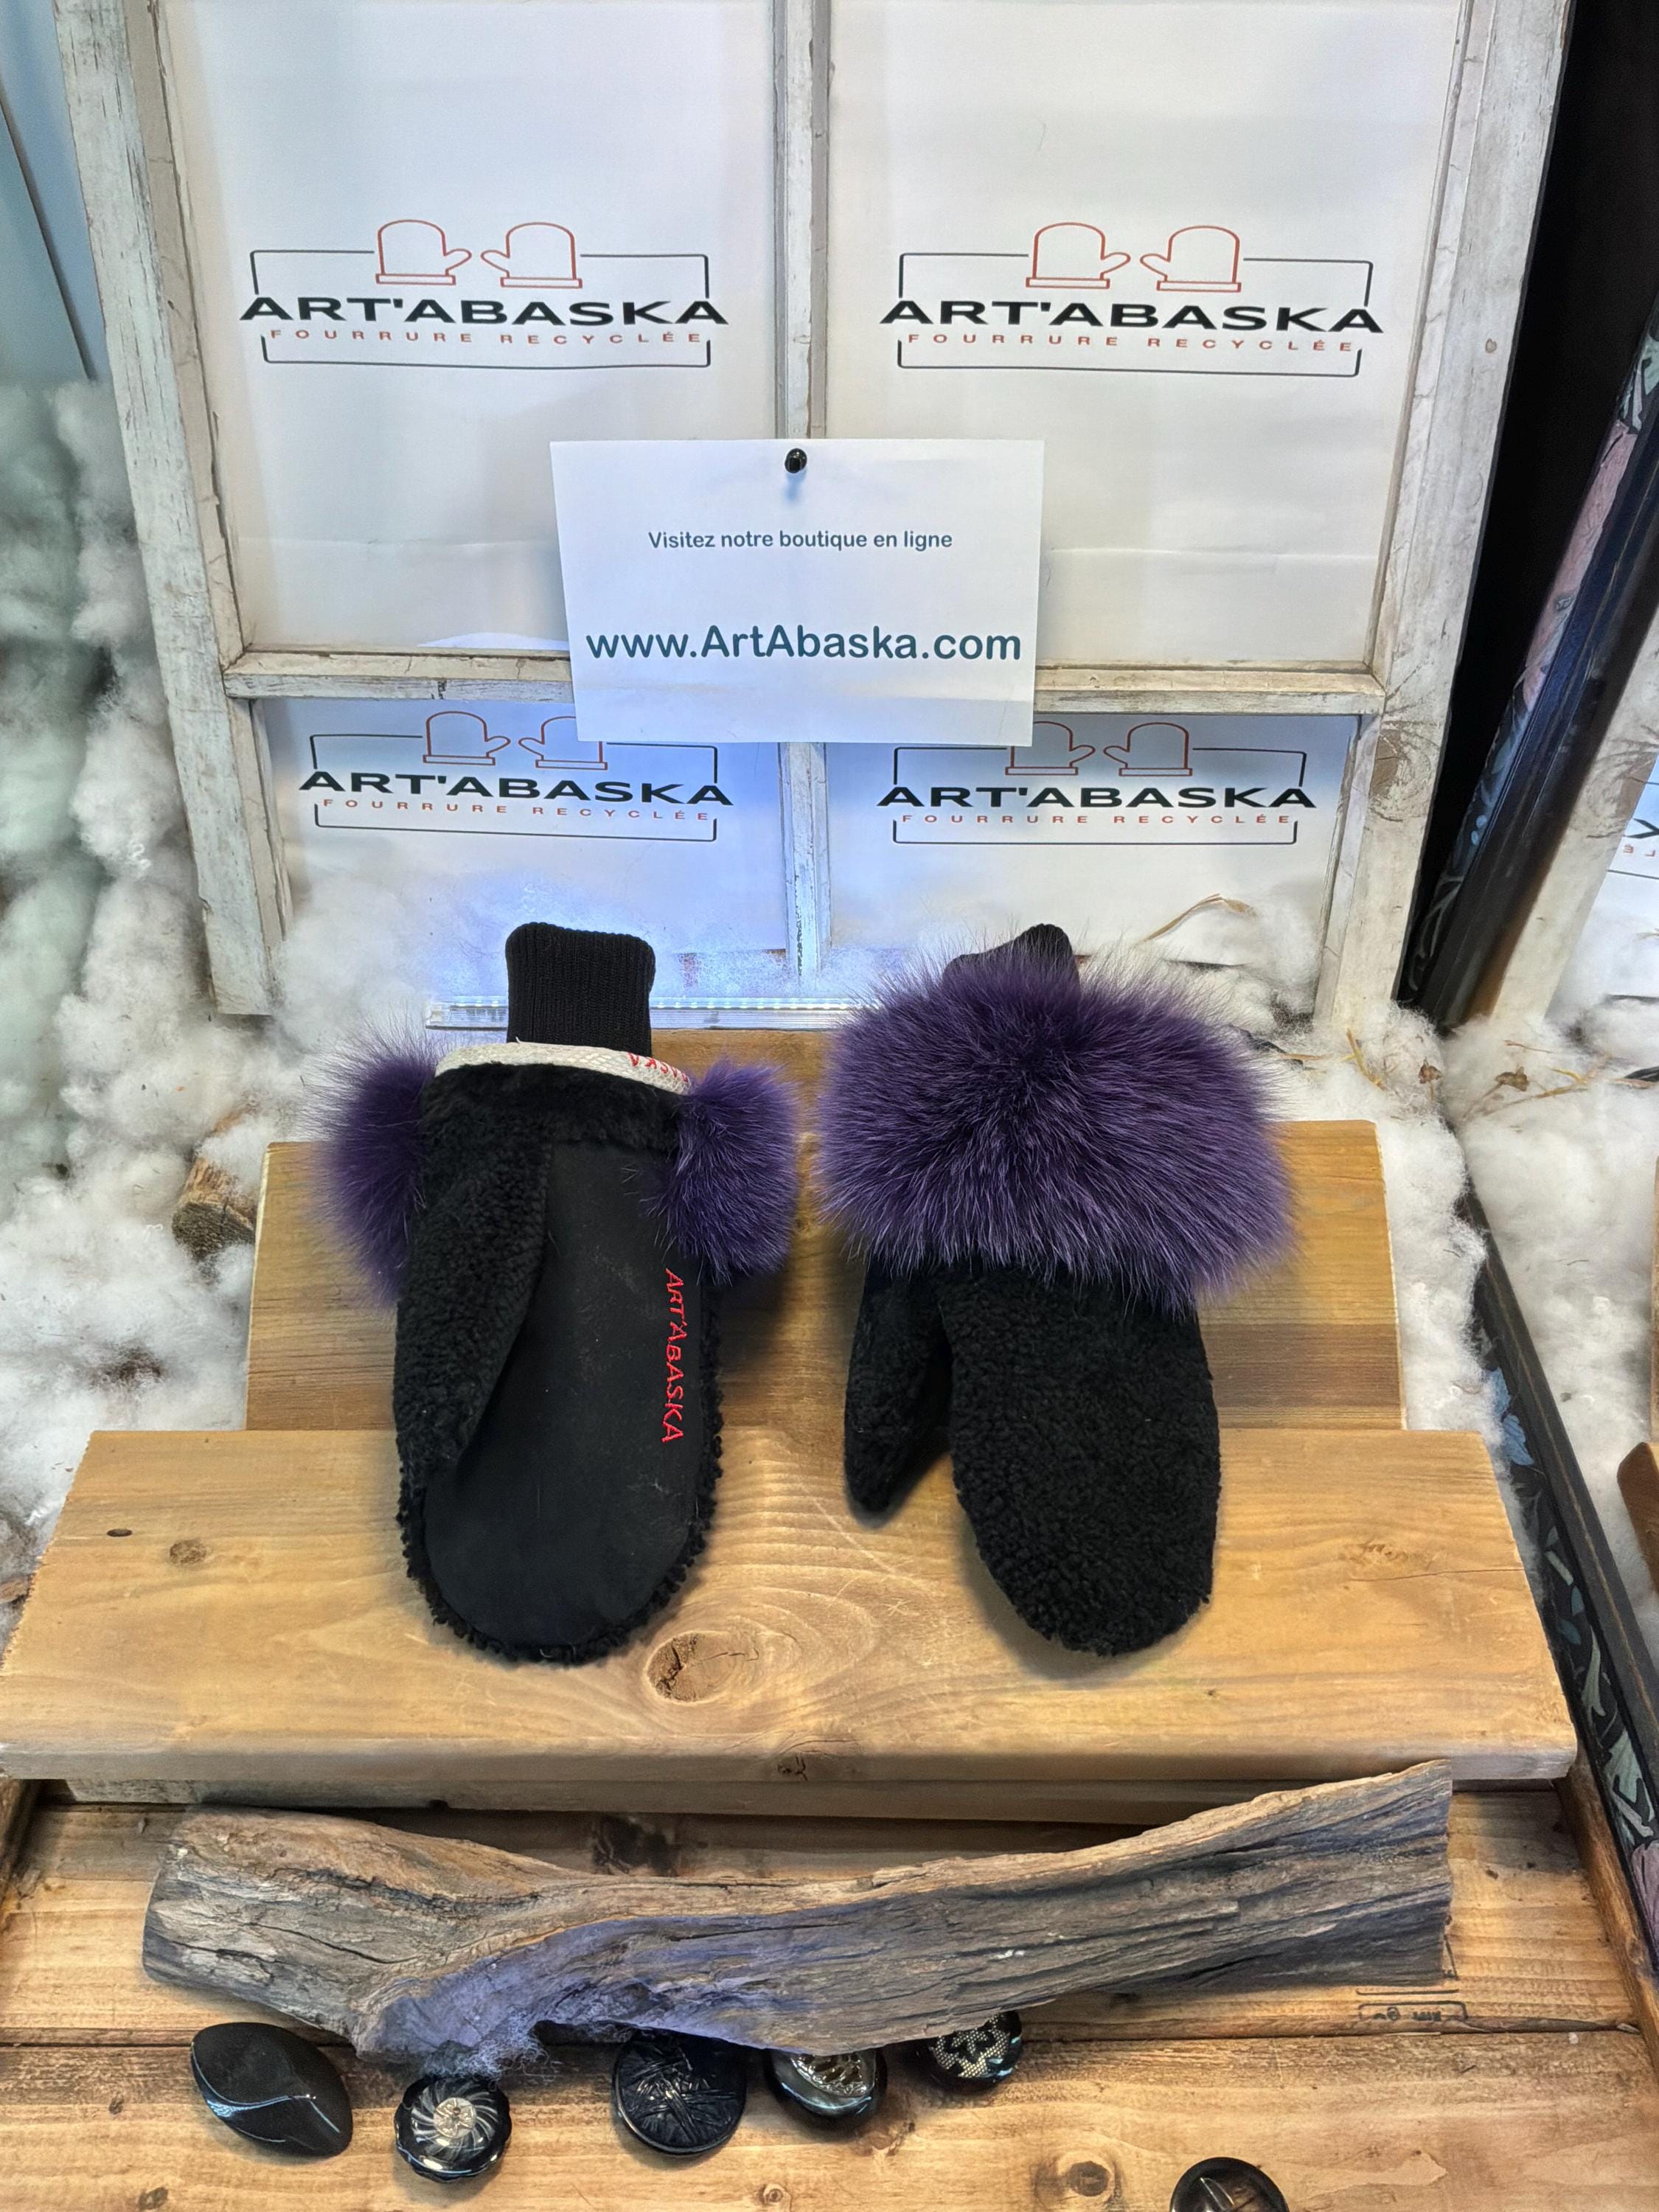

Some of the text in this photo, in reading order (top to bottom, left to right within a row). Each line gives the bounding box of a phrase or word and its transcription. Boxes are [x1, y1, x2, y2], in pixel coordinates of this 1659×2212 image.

[240, 297, 728, 326] ART'ABASKA
[880, 300, 1383, 333] ART'ABASKA
[271, 329, 700, 345] FOURRURE RECYCLÉE
[908, 333, 1352, 352] FOURRURE RECYCLÉE
[648, 529, 953, 552] Visitez notre boutique en ligne
[585, 624, 1021, 661] www.ArtAbaska.com
[299, 771, 734, 806] ART'ABASKA
[877, 786, 1317, 808] ART'ABASKA
[322, 799, 709, 821] FOURRURE RECYCLÉE
[901, 813, 1290, 825] FOURRURE RECYCLÉE
[661, 1267, 688, 1443] ART'ABASKA
